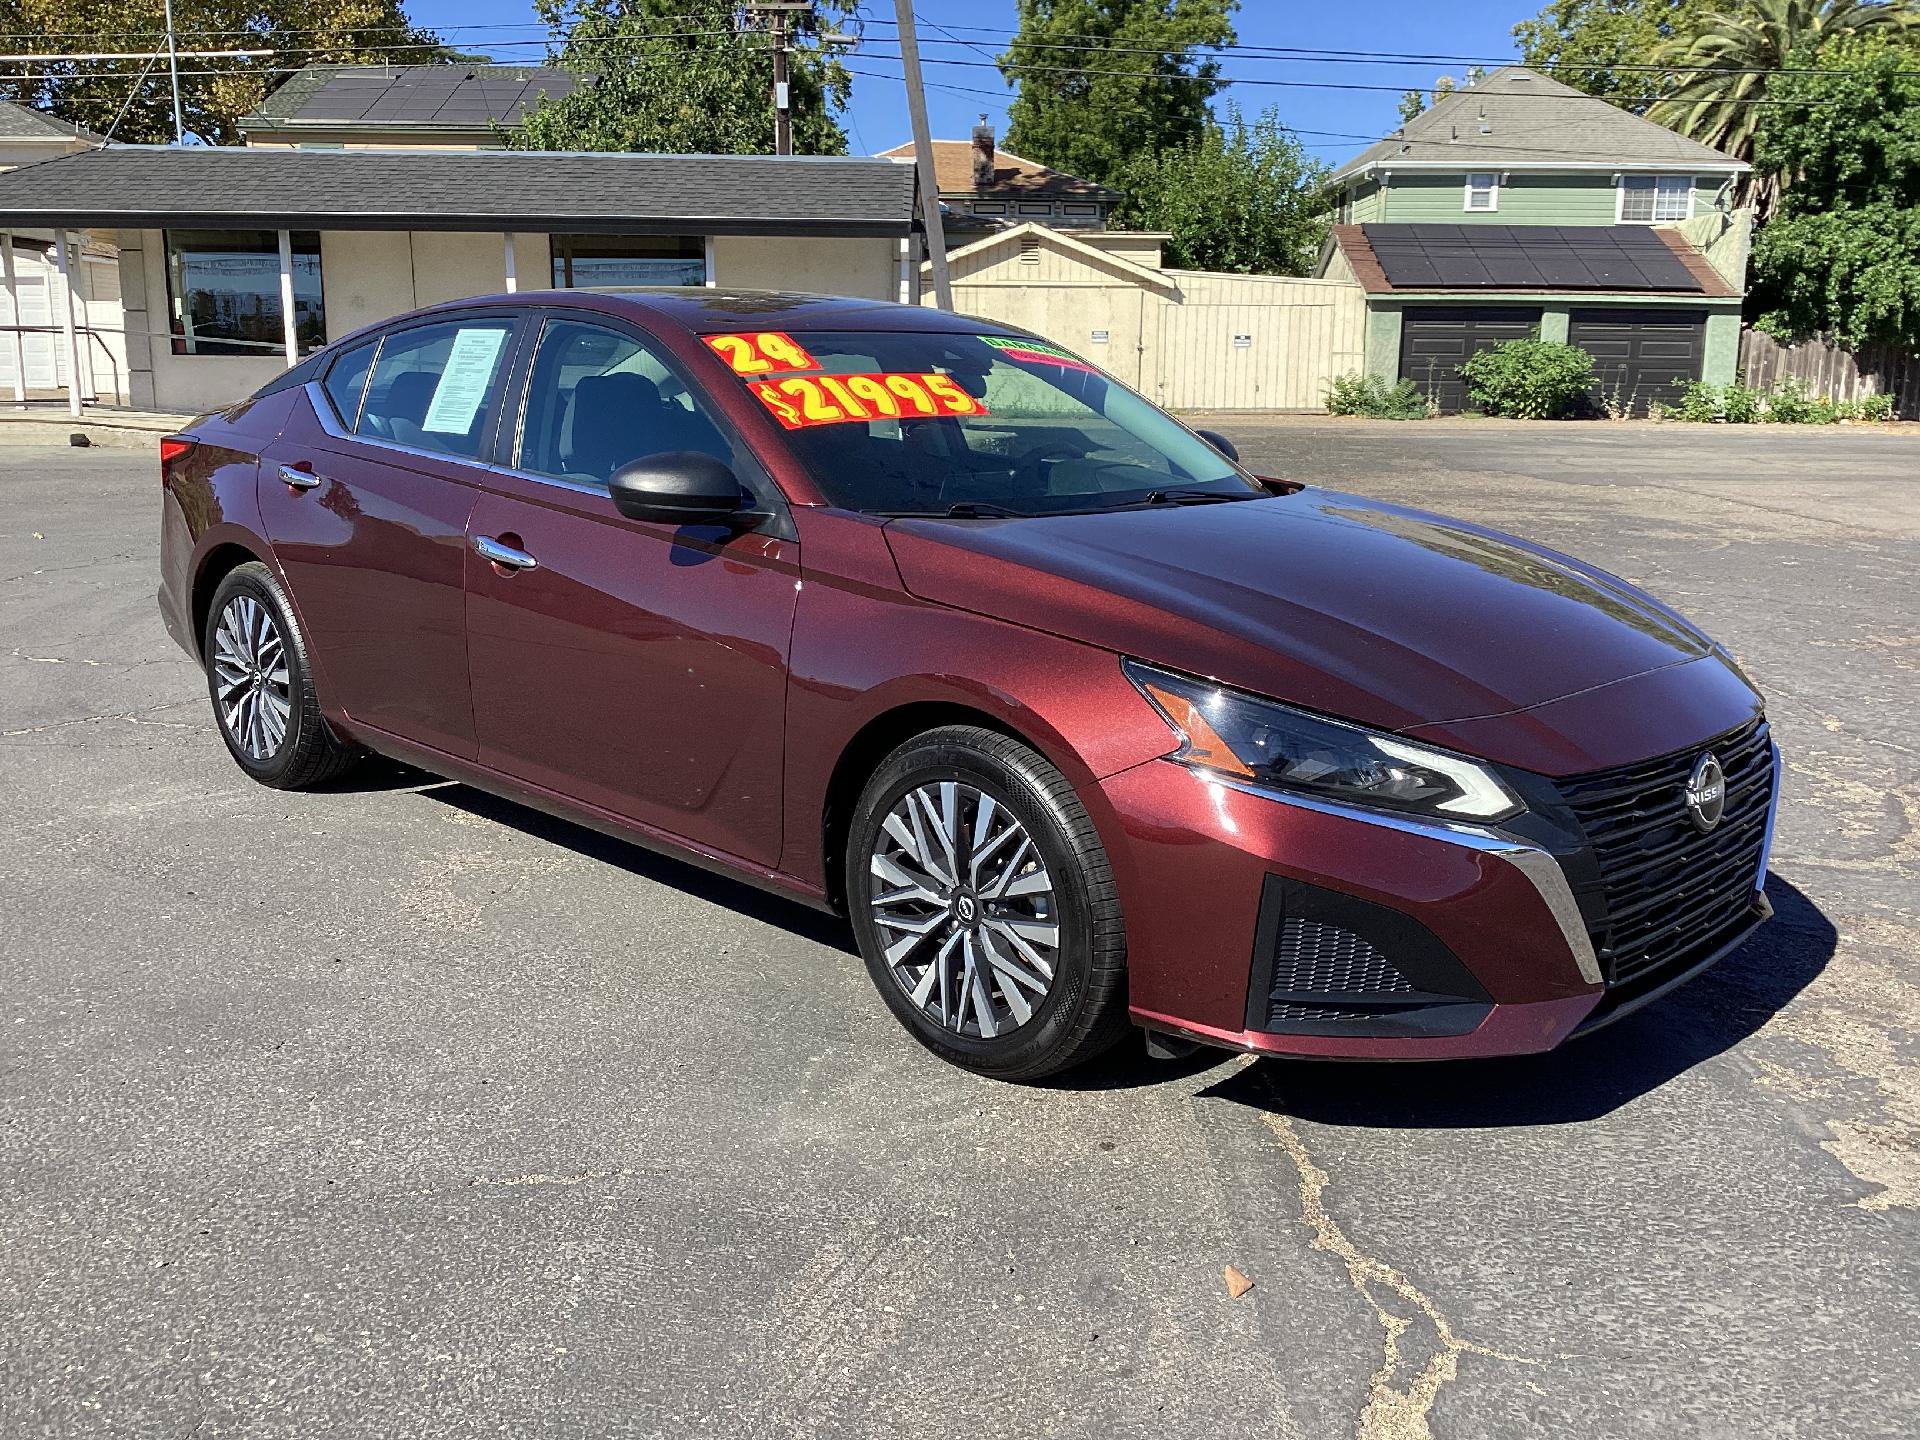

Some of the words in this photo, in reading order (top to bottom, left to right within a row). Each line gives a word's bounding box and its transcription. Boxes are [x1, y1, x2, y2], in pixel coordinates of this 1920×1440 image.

[710, 334, 810, 373] 24
[759, 376, 977, 425] $21995
[1689, 784, 1721, 805] NISS
